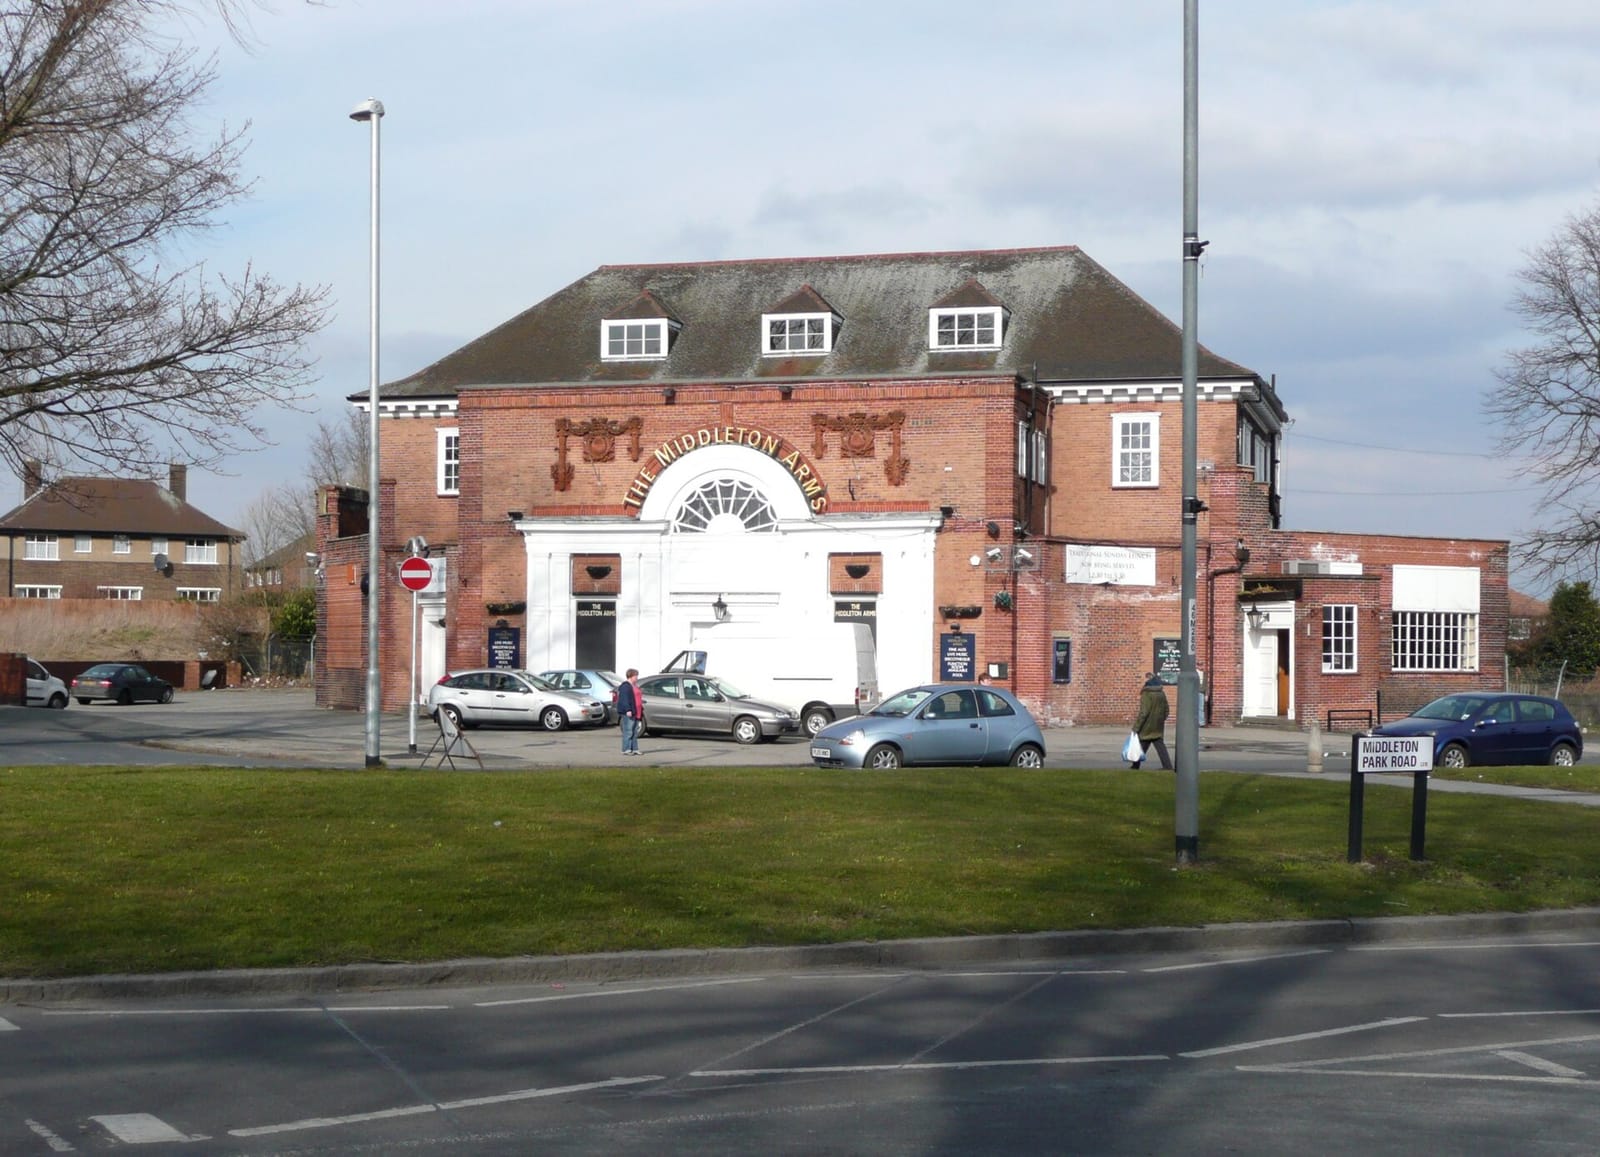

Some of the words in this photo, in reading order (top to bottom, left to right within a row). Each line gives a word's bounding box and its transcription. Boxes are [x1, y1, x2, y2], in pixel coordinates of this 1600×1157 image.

[622, 467, 656, 508] THE
[654, 426, 778, 466] MIDDLETON
[781, 450, 827, 511] ARMS
[1363, 741, 1419, 753] MIDDLETON
[1362, 756, 1388, 768] PARK
[1391, 755, 1417, 767] ROAD
